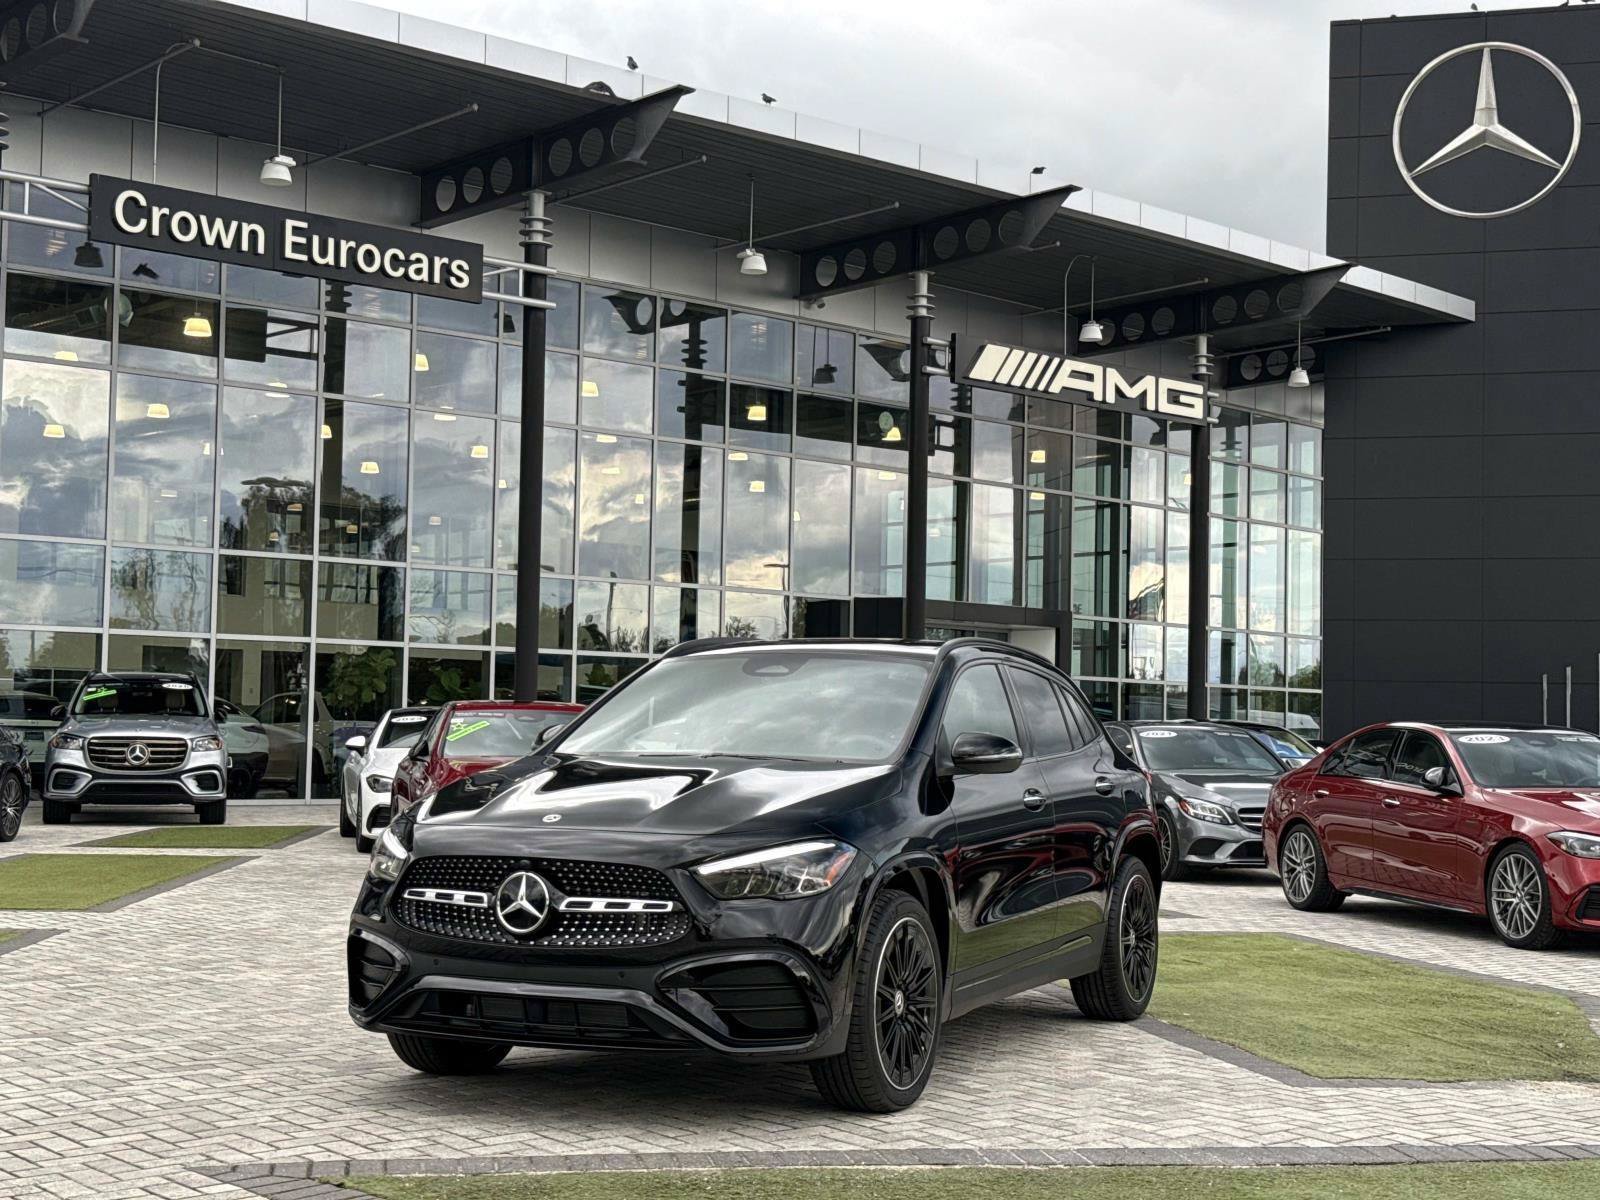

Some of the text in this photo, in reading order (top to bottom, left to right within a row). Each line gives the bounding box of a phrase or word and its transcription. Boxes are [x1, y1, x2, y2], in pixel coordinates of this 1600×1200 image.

[114, 189, 471, 289] Crown Eurocars
[1047, 359, 1204, 419] AMG
